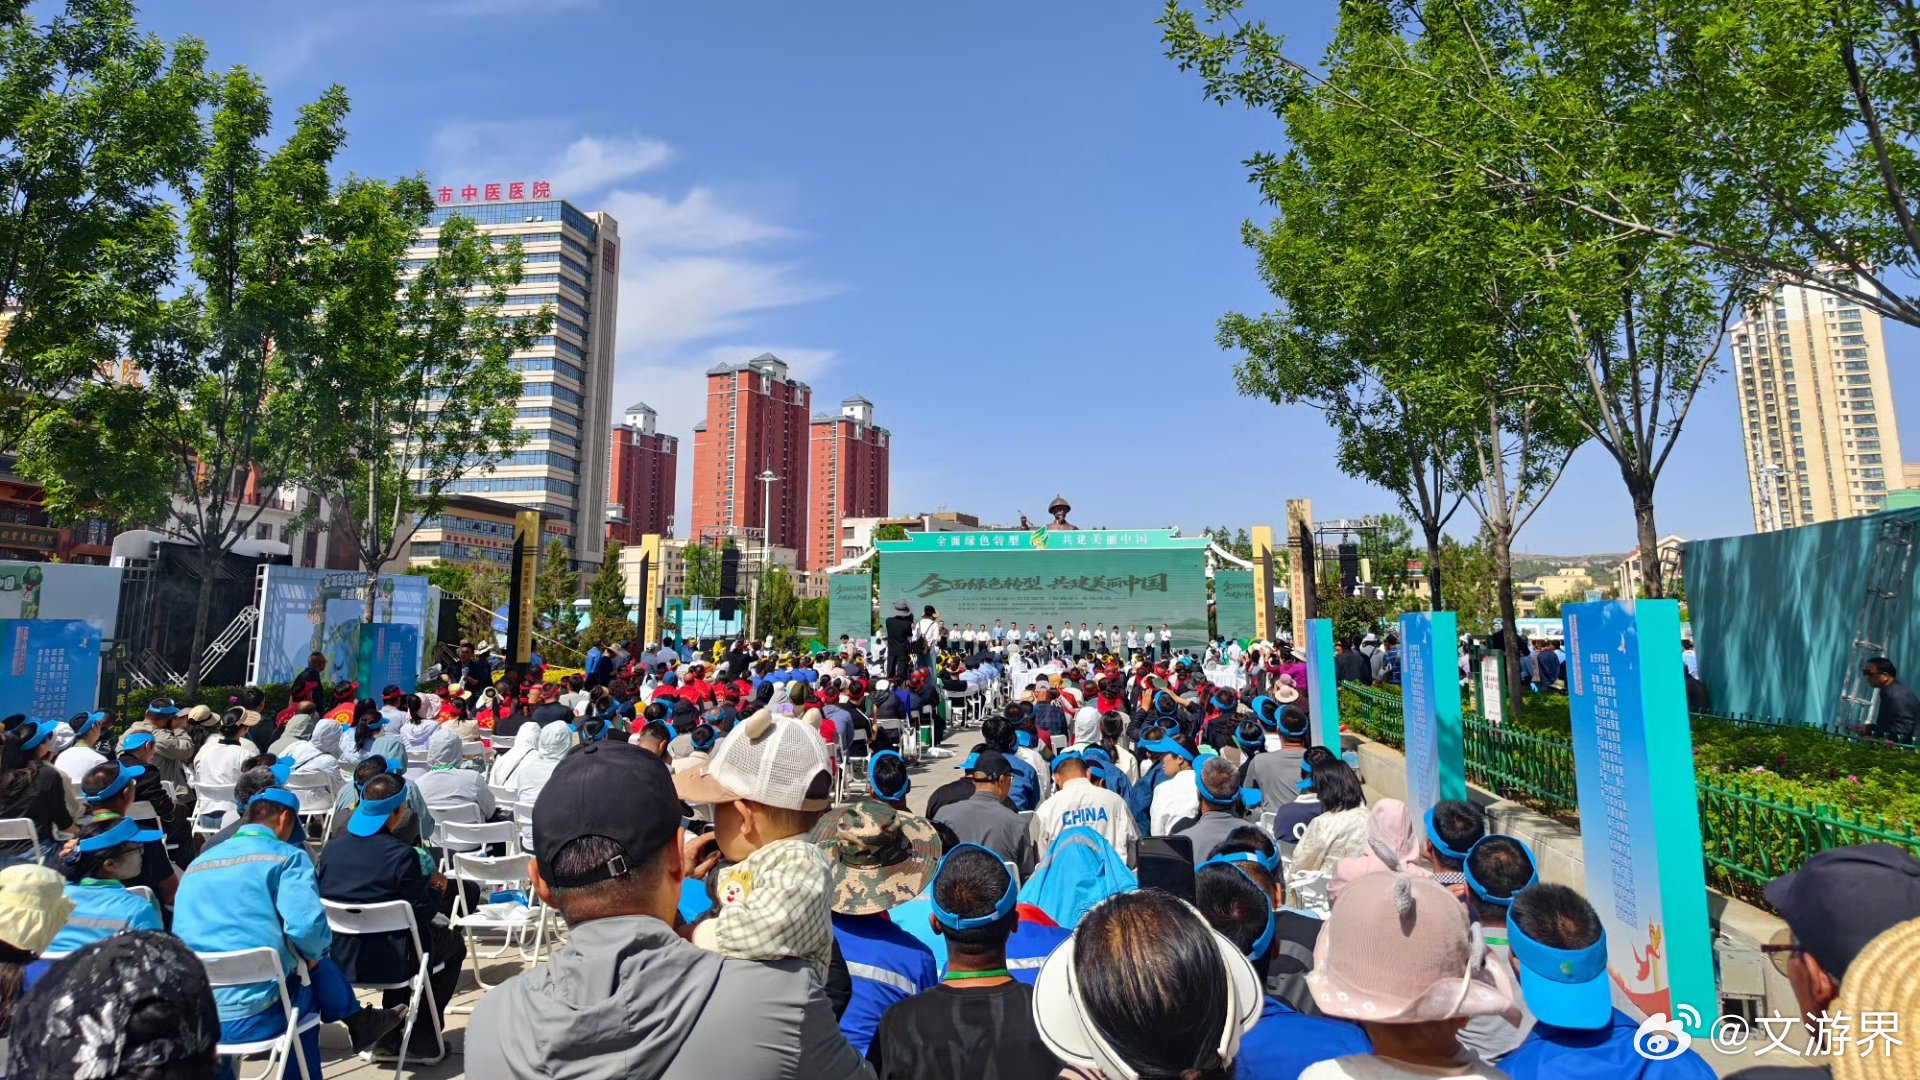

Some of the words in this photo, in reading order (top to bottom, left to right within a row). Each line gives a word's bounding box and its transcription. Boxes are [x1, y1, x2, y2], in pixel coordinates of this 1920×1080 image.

[438, 181, 551, 202] 市中医医院
[936, 534, 1021, 547] 全面绿色转型
[1062, 533, 1148, 546] 共建美丽中国
[903, 572, 1044, 598] 全面绿色转型
[1047, 572, 1169, 597] 共建美丽中国
[1062, 806, 1108, 826] CHINA
